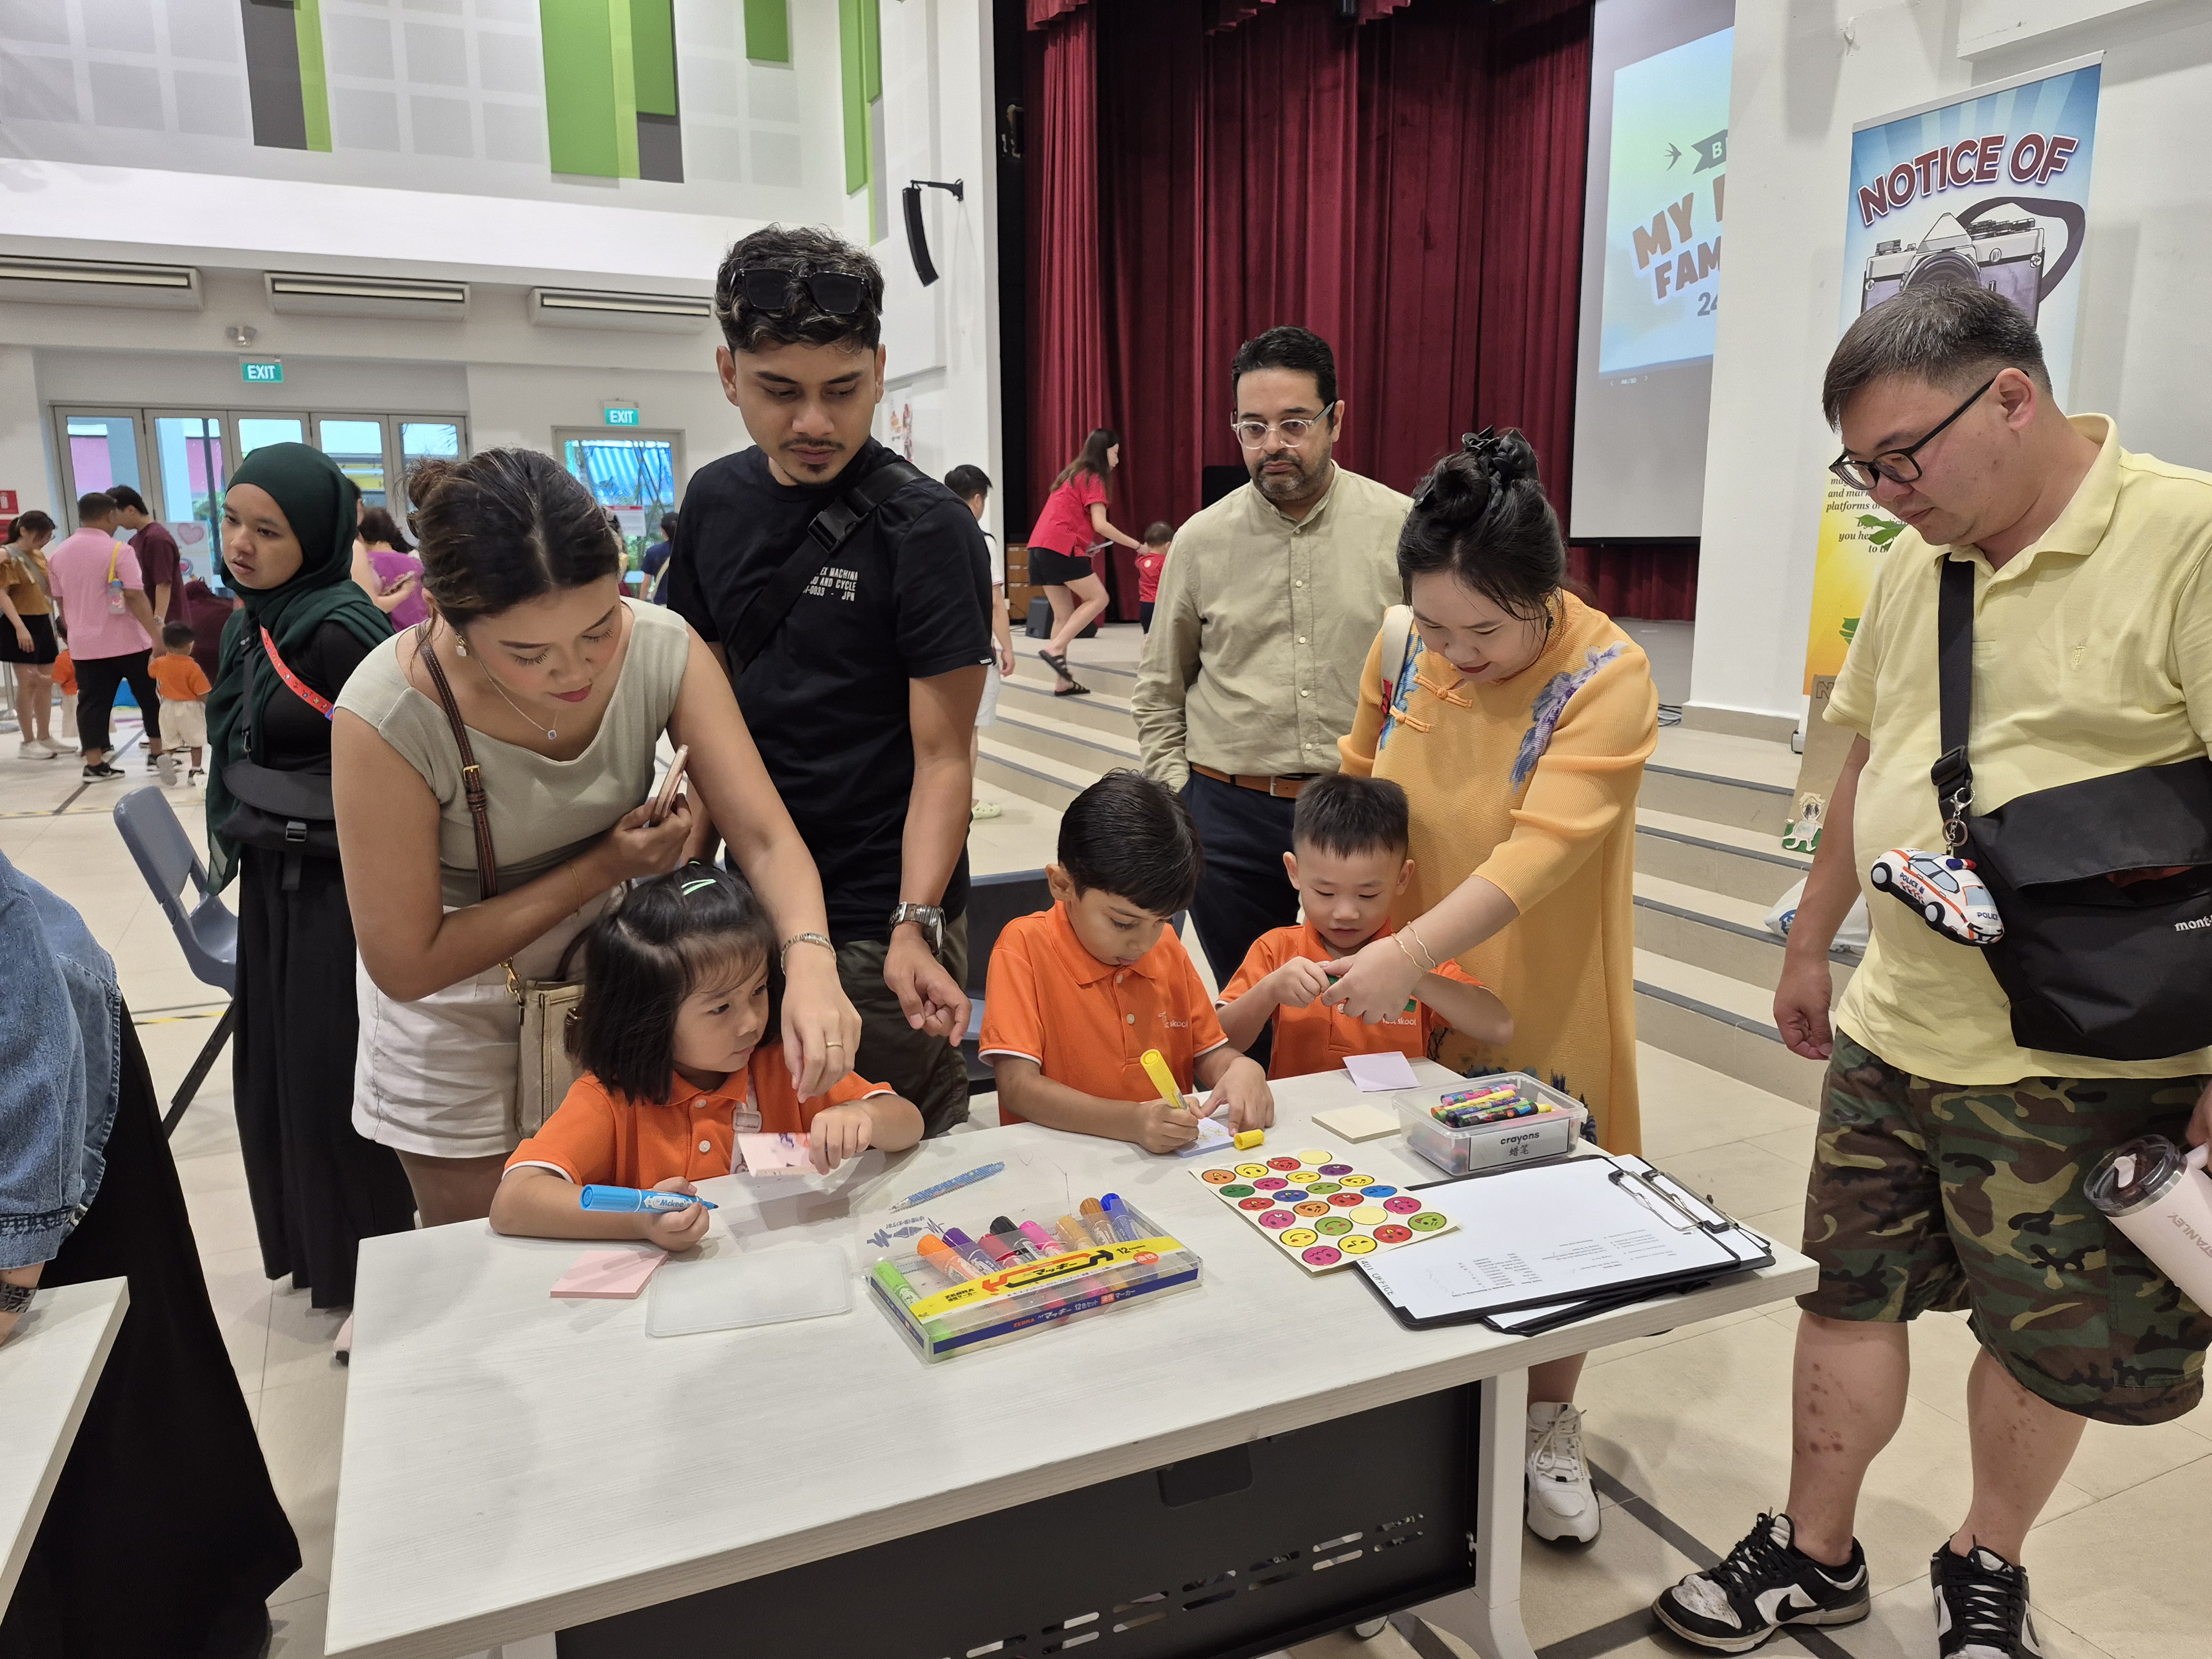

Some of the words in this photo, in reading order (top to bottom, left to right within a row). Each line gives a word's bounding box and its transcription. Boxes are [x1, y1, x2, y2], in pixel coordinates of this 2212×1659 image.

[1712, 137, 1728, 159] B
[1858, 134, 2006, 226] NOTICE
[2008, 133, 2078, 184] OF
[1632, 192, 1694, 270] MY
[247, 364, 276, 380] EXIT
[609, 410, 634, 424] EXIT
[1828, 489, 1844, 498] and
[1826, 502, 1870, 512] platforms
[829, 567, 858, 581] MACHINA
[820, 577, 833, 587] AND
[835, 579, 857, 591] CYCLE
[841, 591, 855, 602] JPN
[1900, 872, 1918, 889] POLICE
[1977, 912, 1999, 920] POLICE
[1397, 1017, 1416, 1025] skool
[1500, 1131, 1540, 1145] crayons
[1509, 1144, 1530, 1156] 蜡笔
[660, 1199, 685, 1207] Mckee
[1372, 1273, 1394, 1296] OFFICE
[945, 1287, 974, 1298] ZEBRA
[1013, 1318, 1035, 1327] ZEBRA
